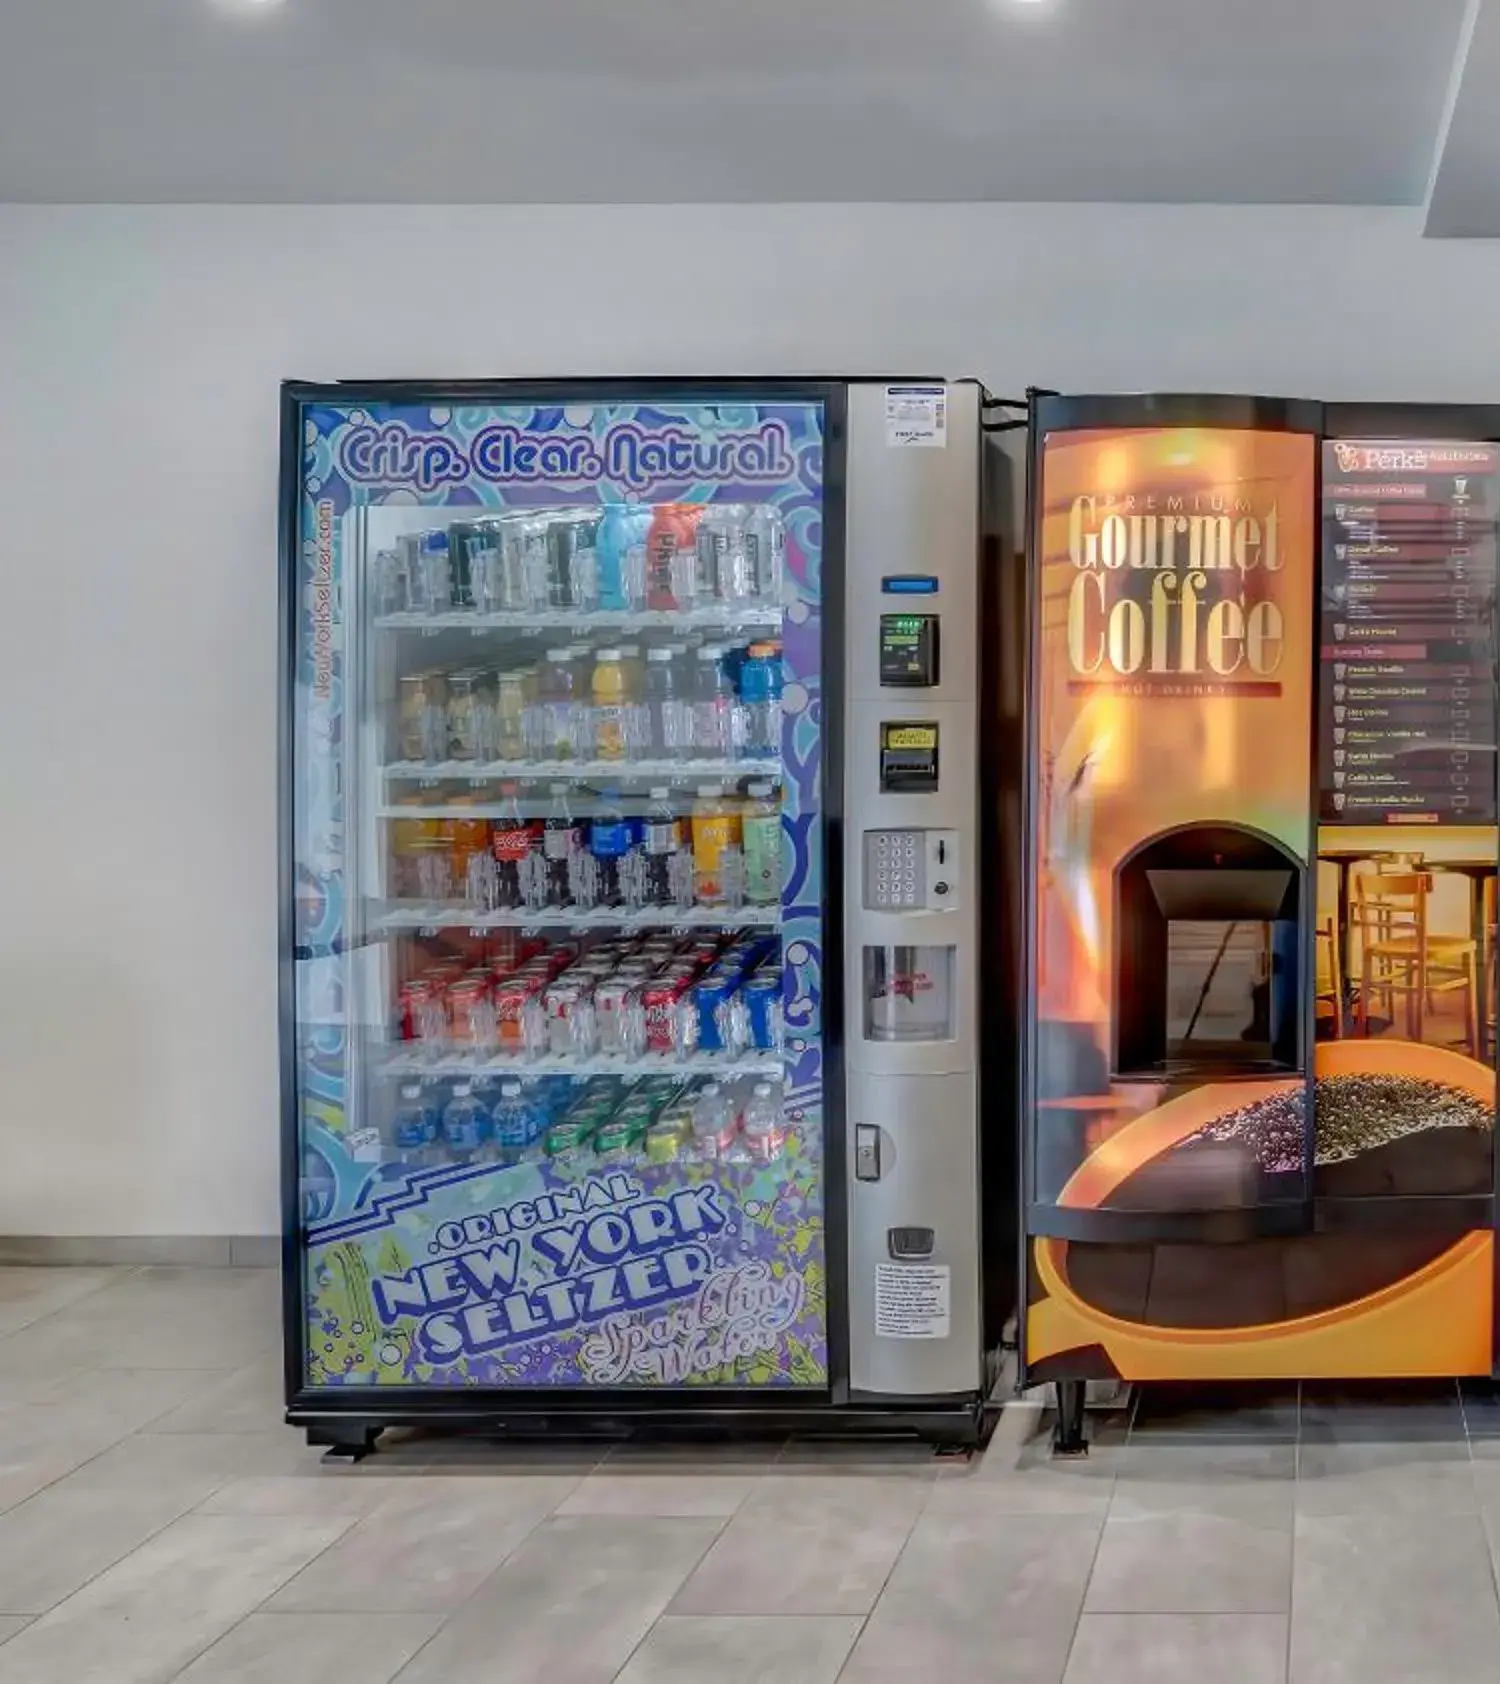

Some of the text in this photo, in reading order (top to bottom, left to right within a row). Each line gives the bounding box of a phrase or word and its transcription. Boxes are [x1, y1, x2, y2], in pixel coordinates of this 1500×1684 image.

[342, 420, 794, 489] Crisp. Clear. Natural.
[1366, 448, 1428, 470] Perks
[1068, 494, 1285, 571] Gourmet
[1102, 495, 1252, 511] PREMIUM
[1067, 570, 1284, 675] Coffee
[434, 1173, 642, 1251] ORIGINAL
[371, 1186, 727, 1325] NEW YORK
[416, 1244, 716, 1366] SELTZER
[582, 1266, 803, 1384] Sparkling
